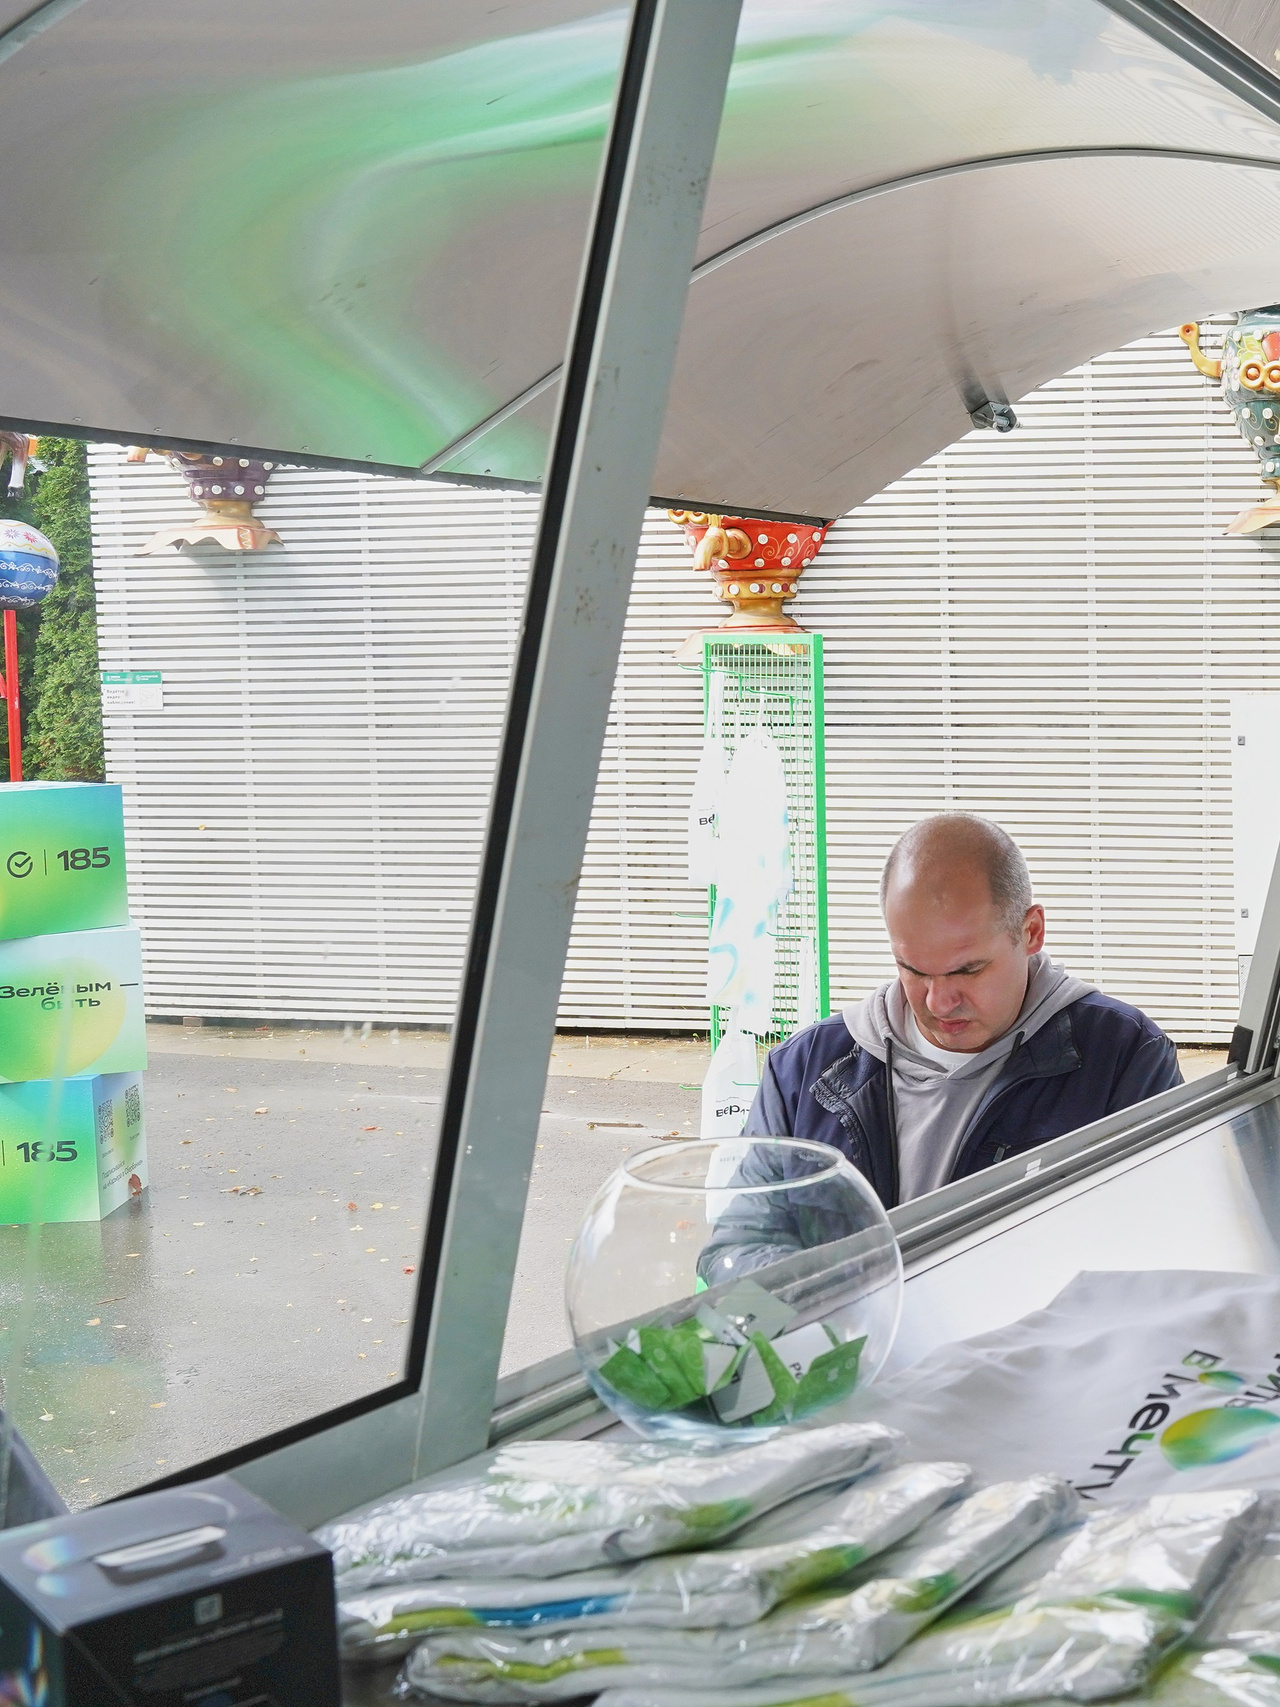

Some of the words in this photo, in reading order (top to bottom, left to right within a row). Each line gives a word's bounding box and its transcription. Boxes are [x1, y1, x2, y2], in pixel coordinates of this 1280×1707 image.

[57, 846, 111, 871] 185
[0, 982, 111, 999] Зелёым
[17, 1141, 78, 1162] 185
